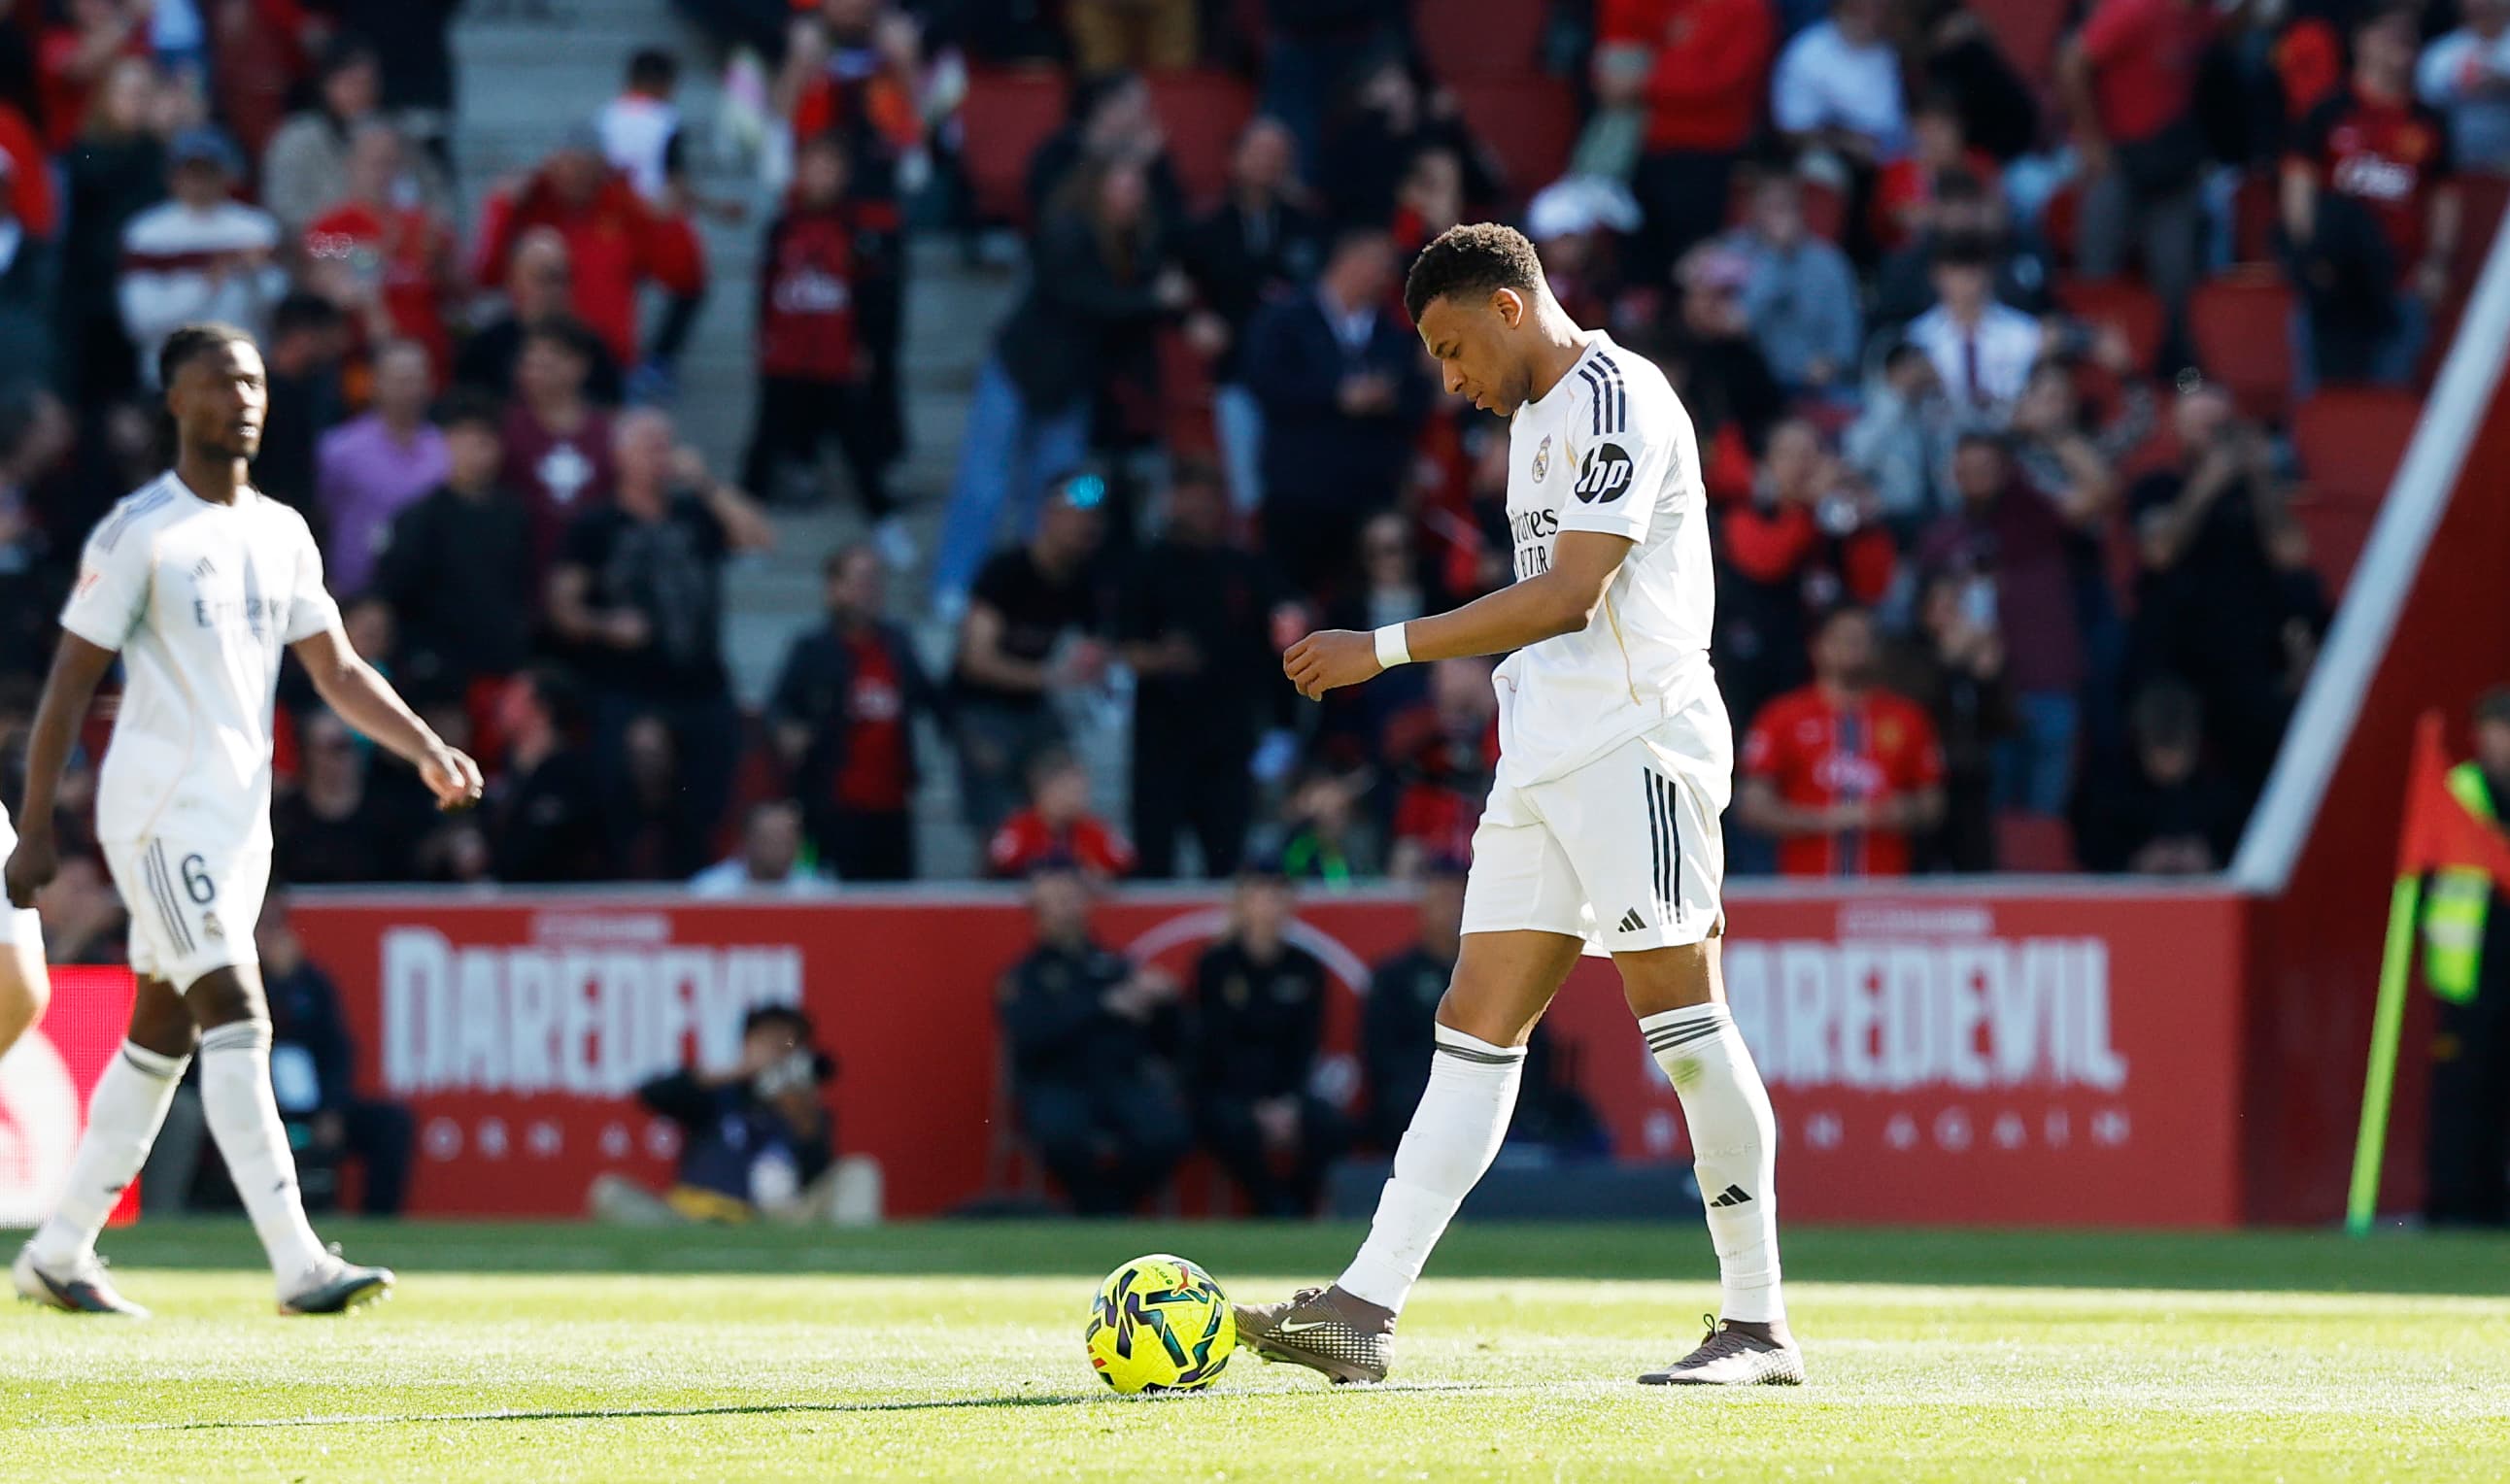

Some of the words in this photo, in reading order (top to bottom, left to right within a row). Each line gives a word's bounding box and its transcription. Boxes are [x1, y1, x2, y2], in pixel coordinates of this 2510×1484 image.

[1576, 443, 1634, 504] hp
[182, 852, 216, 904] 6
[1721, 936, 2127, 1090] AREDEVIL
